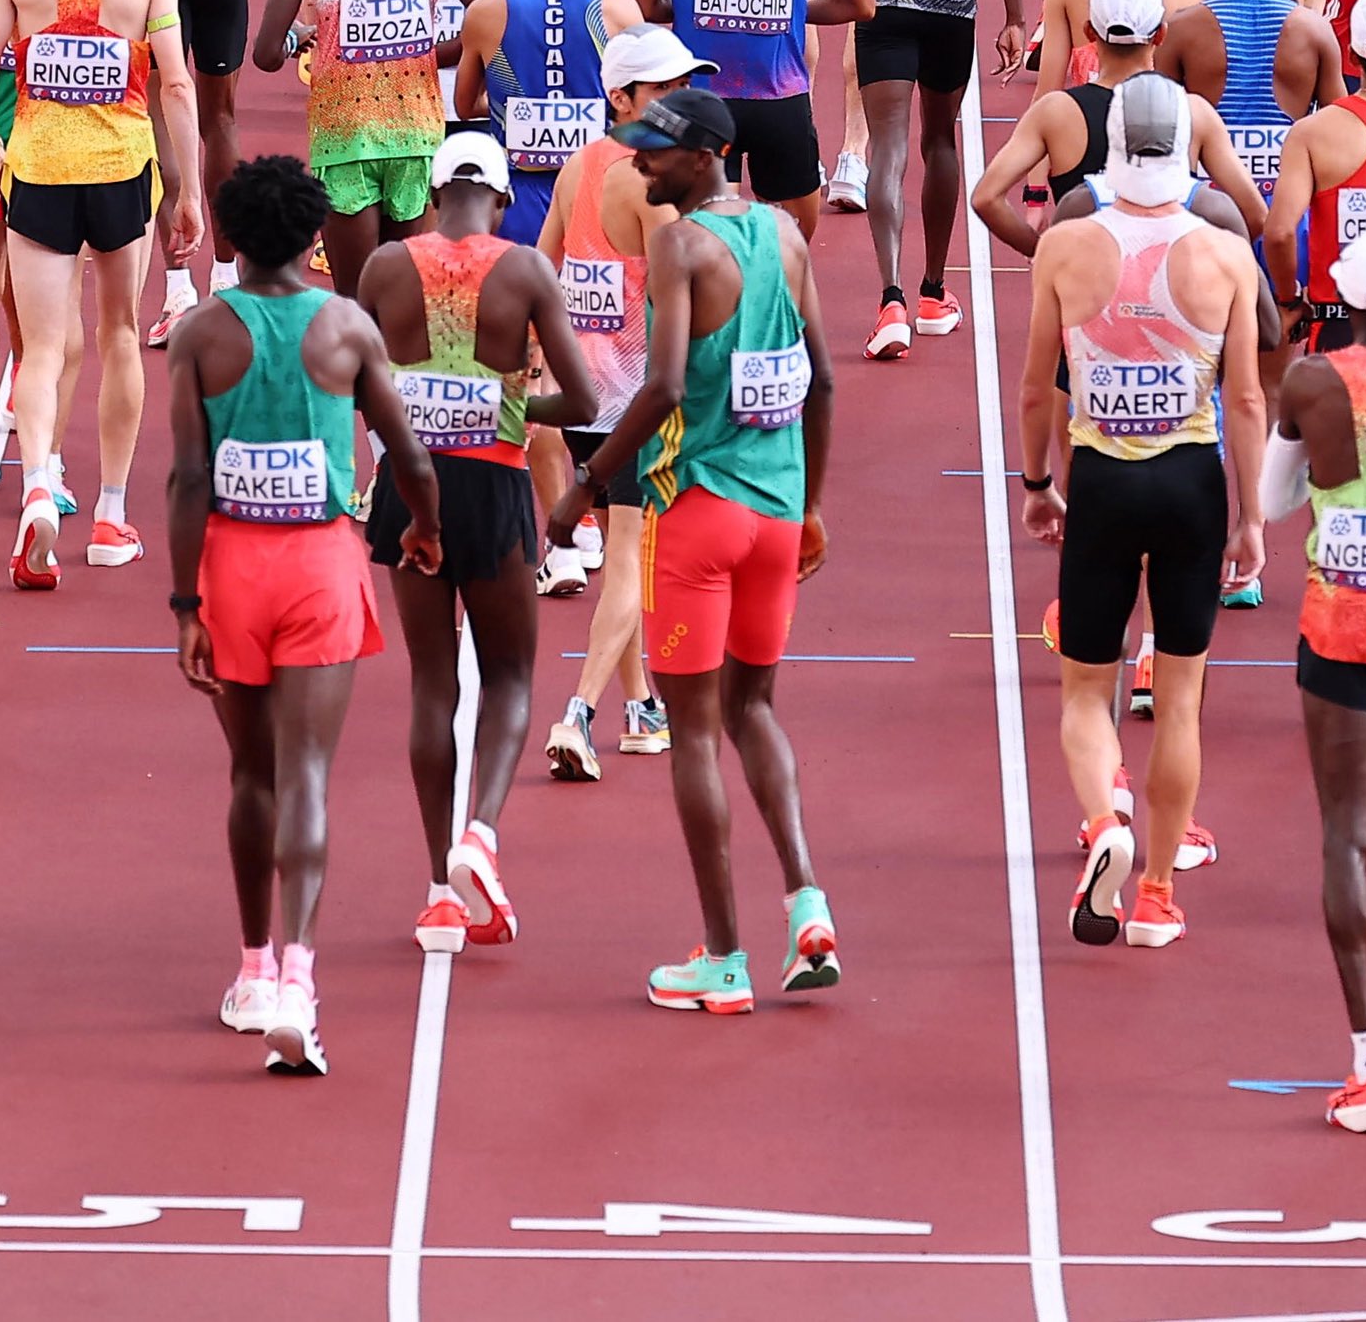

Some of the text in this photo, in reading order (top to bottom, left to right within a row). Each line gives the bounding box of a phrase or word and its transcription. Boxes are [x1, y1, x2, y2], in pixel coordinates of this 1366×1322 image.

[347, 18, 428, 43] BIZOZA
[56, 38, 119, 59] TDK
[34, 63, 121, 86] RINGER
[532, 103, 596, 122] TDK
[522, 128, 587, 148] JAMI
[1228, 130, 1285, 149] TDK
[1119, 365, 1184, 387] TDK
[421, 378, 490, 404] TDK
[1088, 392, 1188, 416] NAERT
[242, 448, 315, 469] TDK
[221, 473, 319, 499] TAKELE
[510, 1201, 933, 1237] 4
